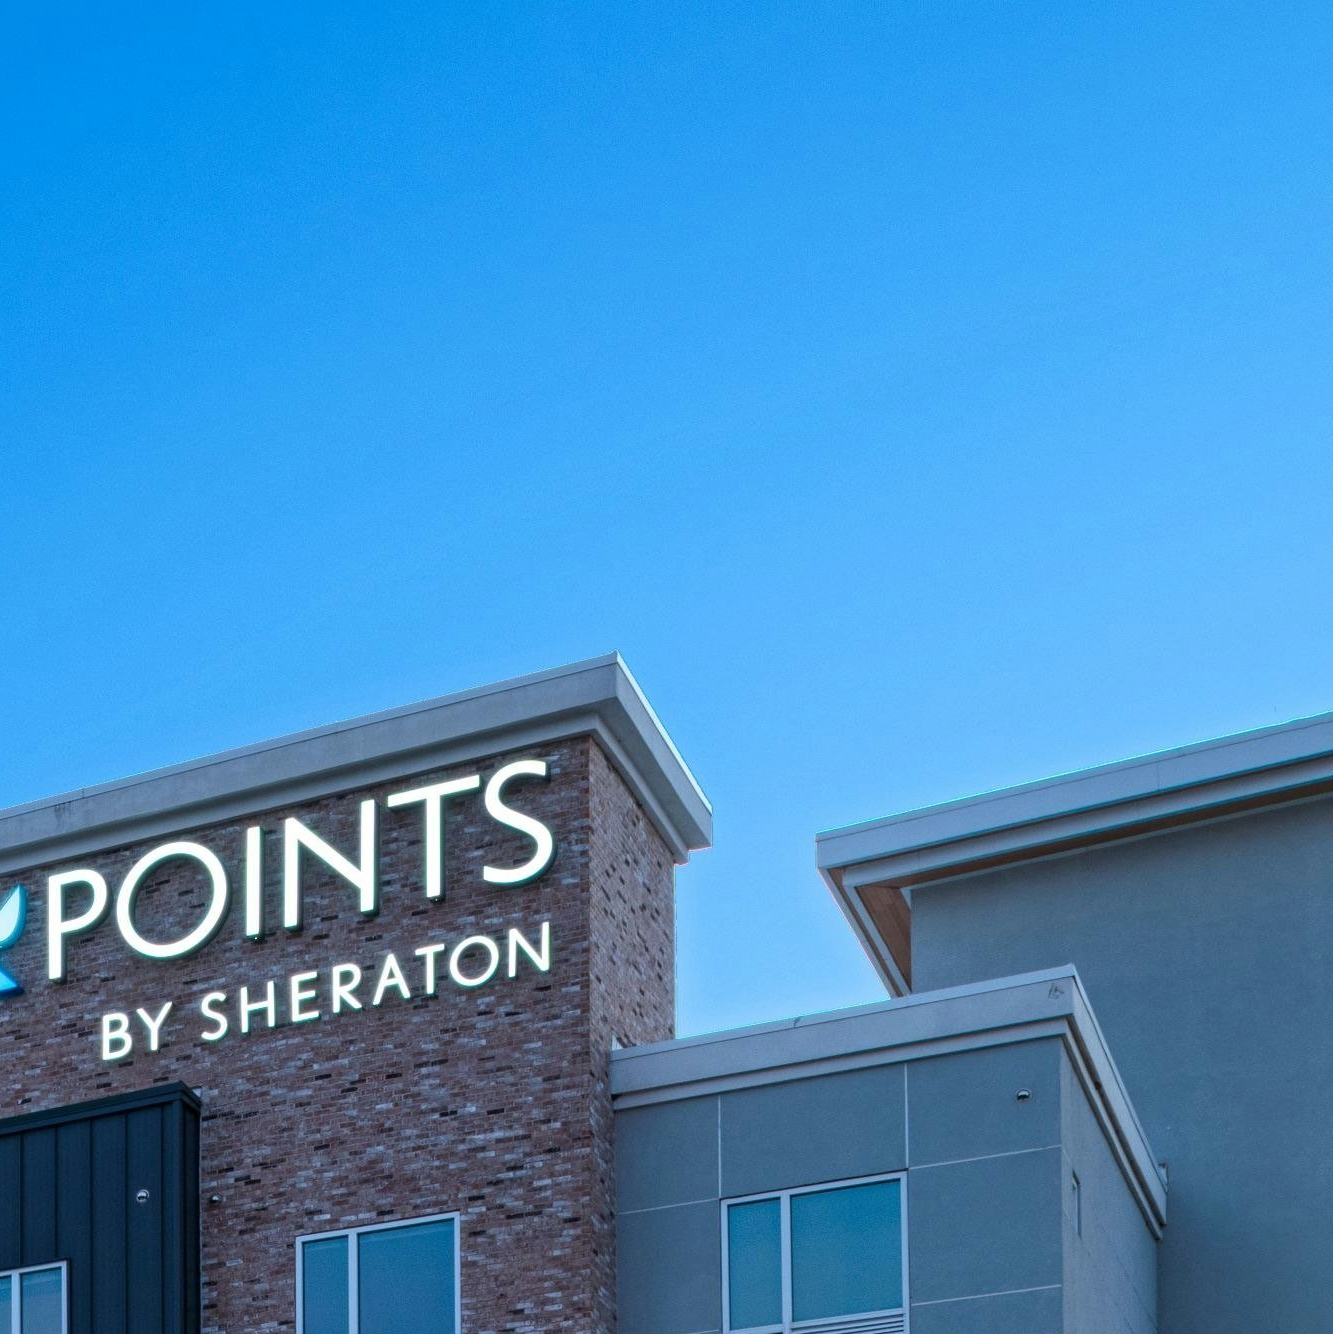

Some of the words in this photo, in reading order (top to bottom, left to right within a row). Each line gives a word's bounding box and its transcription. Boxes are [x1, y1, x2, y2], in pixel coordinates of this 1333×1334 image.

[47, 760, 555, 981] POINTS
[101, 1001, 173, 1061] BY
[201, 922, 550, 1041] SHERATON
